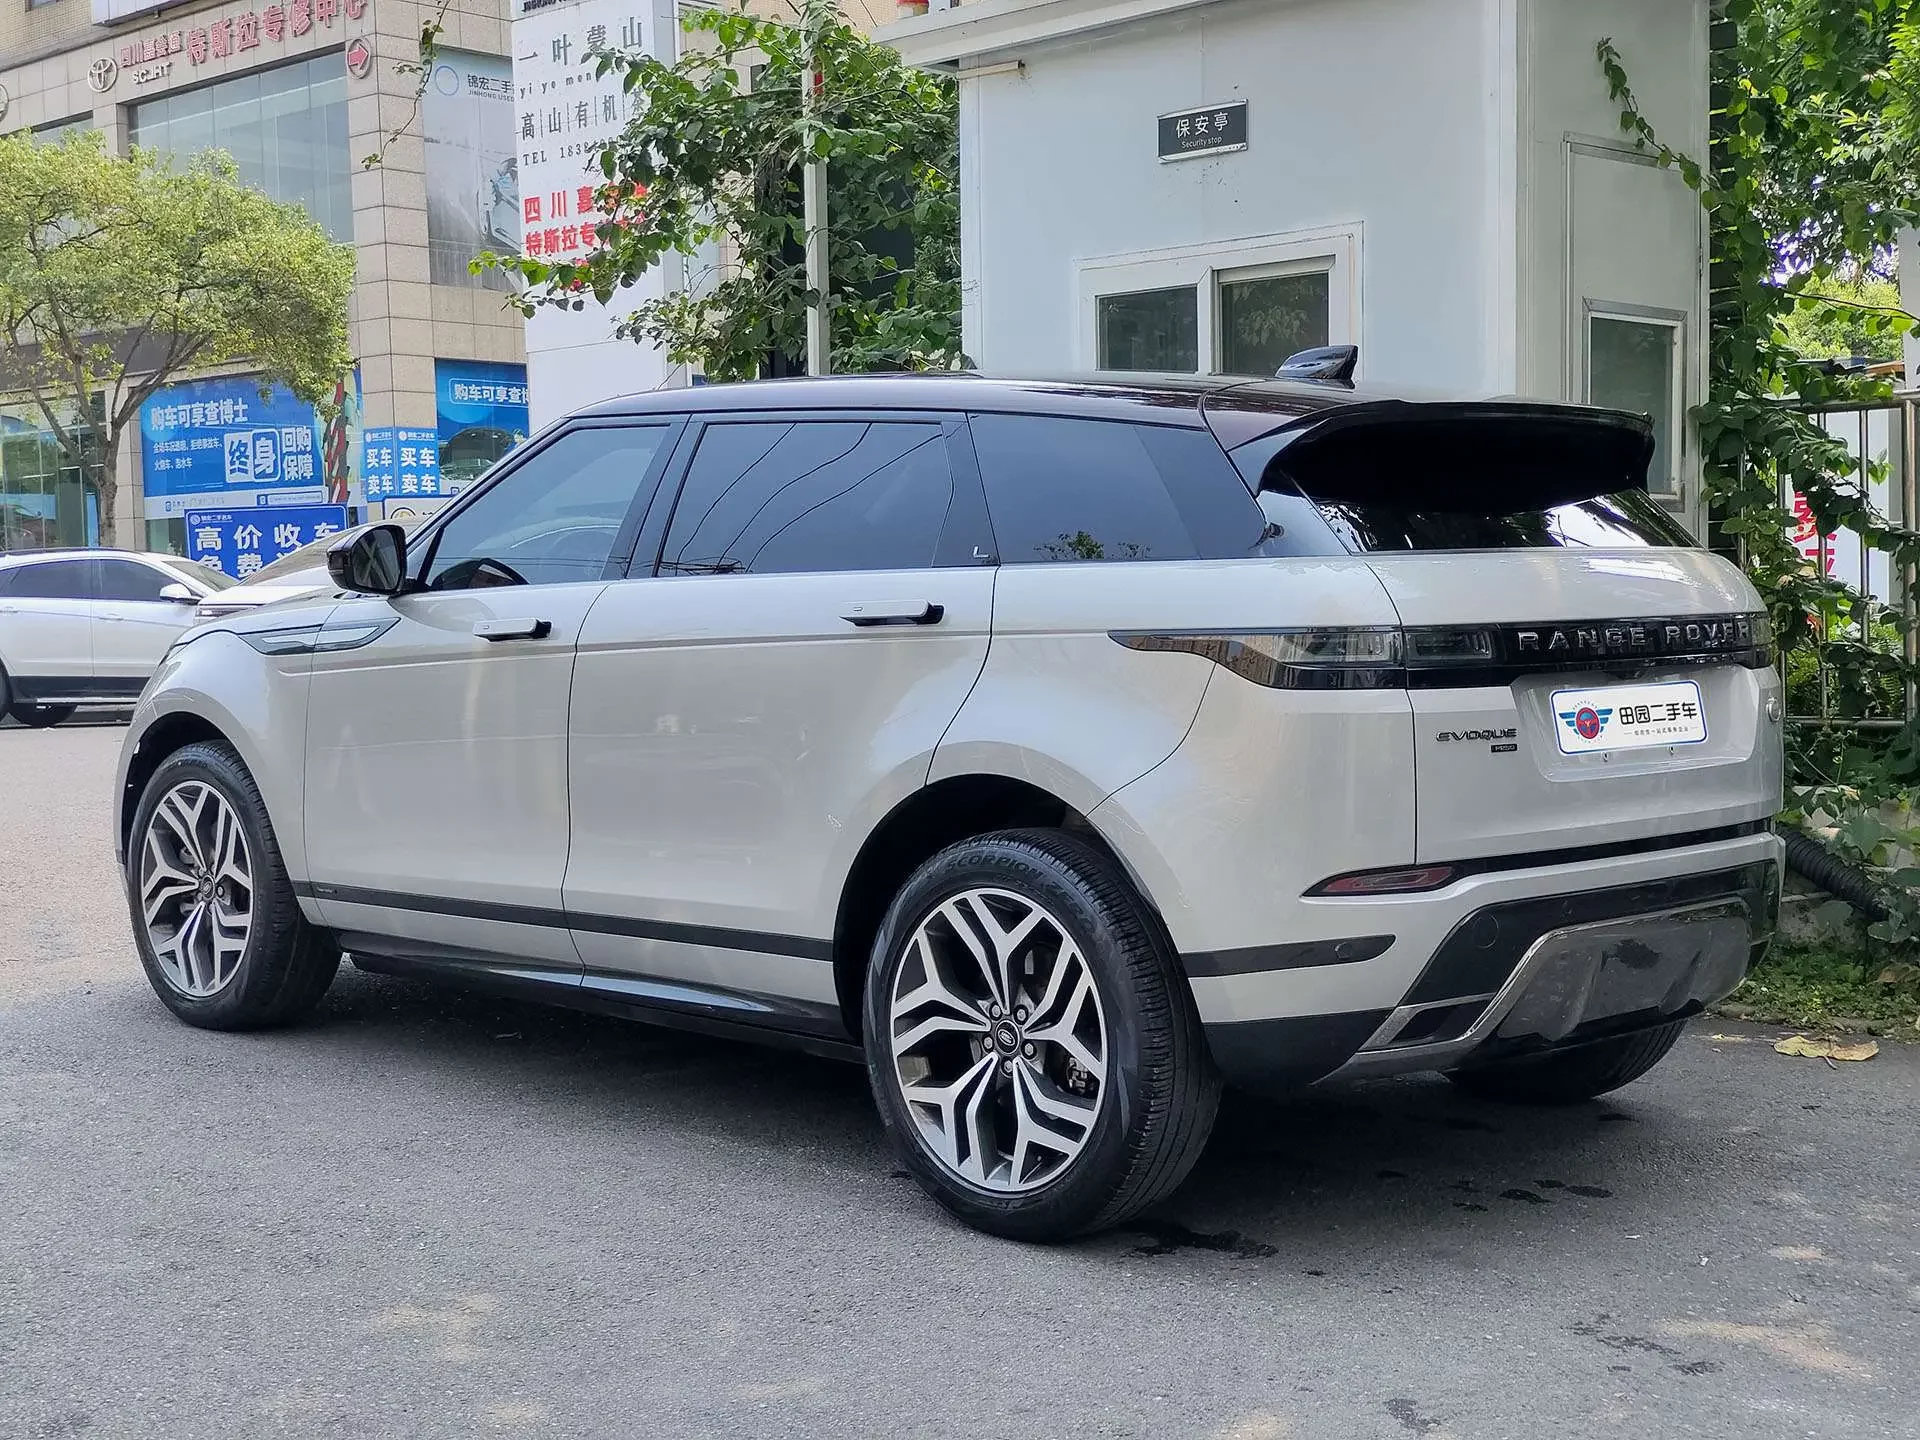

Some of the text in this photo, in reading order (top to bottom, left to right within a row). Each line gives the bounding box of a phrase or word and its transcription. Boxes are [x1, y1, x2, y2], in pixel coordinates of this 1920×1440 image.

[186, 0, 367, 65] 特斯拉专修中心
[467, 74, 514, 94] 锦宏二手
[1176, 112, 1228, 138] 保安亭
[1181, 136, 1223, 149] Security stop
[523, 150, 547, 166] TEL
[151, 398, 248, 431] 购车可享查博士
[281, 426, 312, 453] 回购
[229, 438, 276, 475] 终身
[283, 454, 314, 481] 保障
[366, 447, 393, 468] 买车
[400, 447, 436, 468] 买车
[367, 474, 394, 495] 卖车
[401, 474, 437, 494] 卖车
[194, 523, 339, 551] 高价收车
[200, 552, 288, 578] 免费
[1517, 621, 1750, 651] RANGE ROVER
[1619, 702, 1697, 725] 田园二手车
[1436, 728, 1517, 742] EVOQUE
[946, 853, 1045, 881] SCORPION
